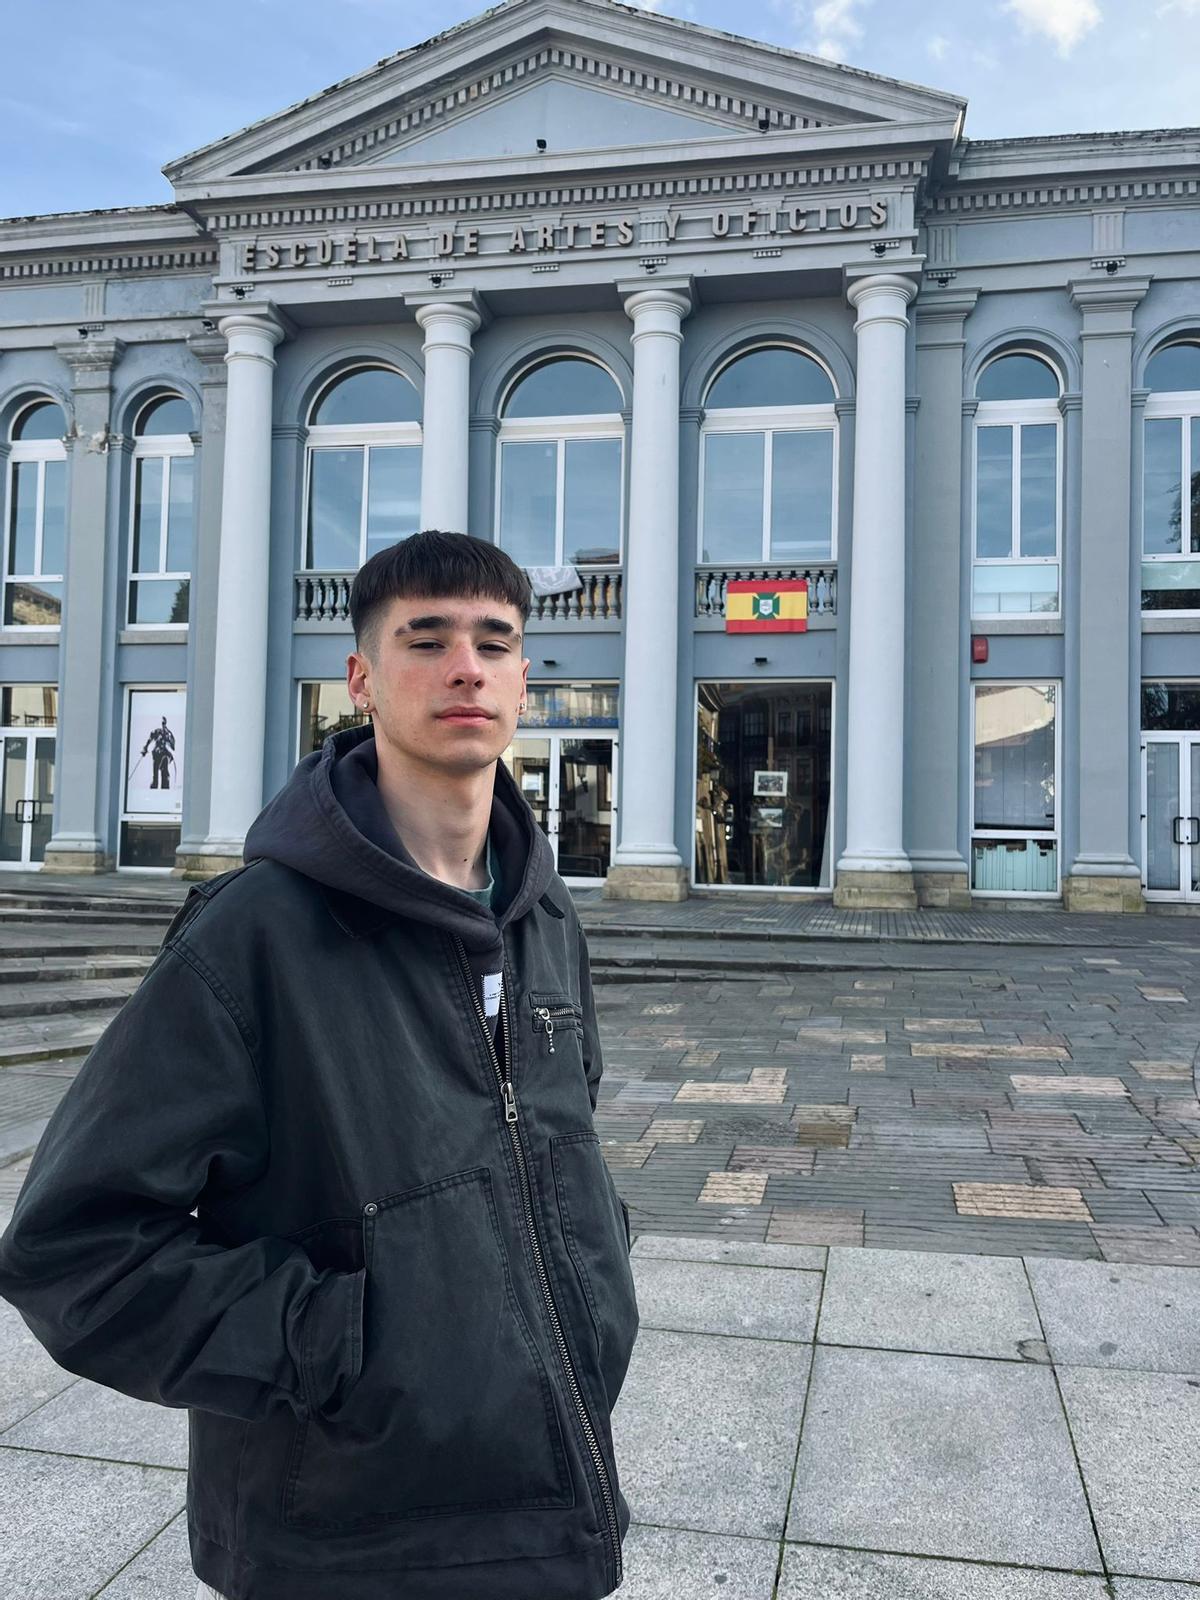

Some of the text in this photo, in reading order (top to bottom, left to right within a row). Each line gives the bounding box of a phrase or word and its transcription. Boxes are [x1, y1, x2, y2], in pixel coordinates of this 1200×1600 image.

[243, 200, 887, 269] ESCUELA DE ARTES Y OFICIOS
